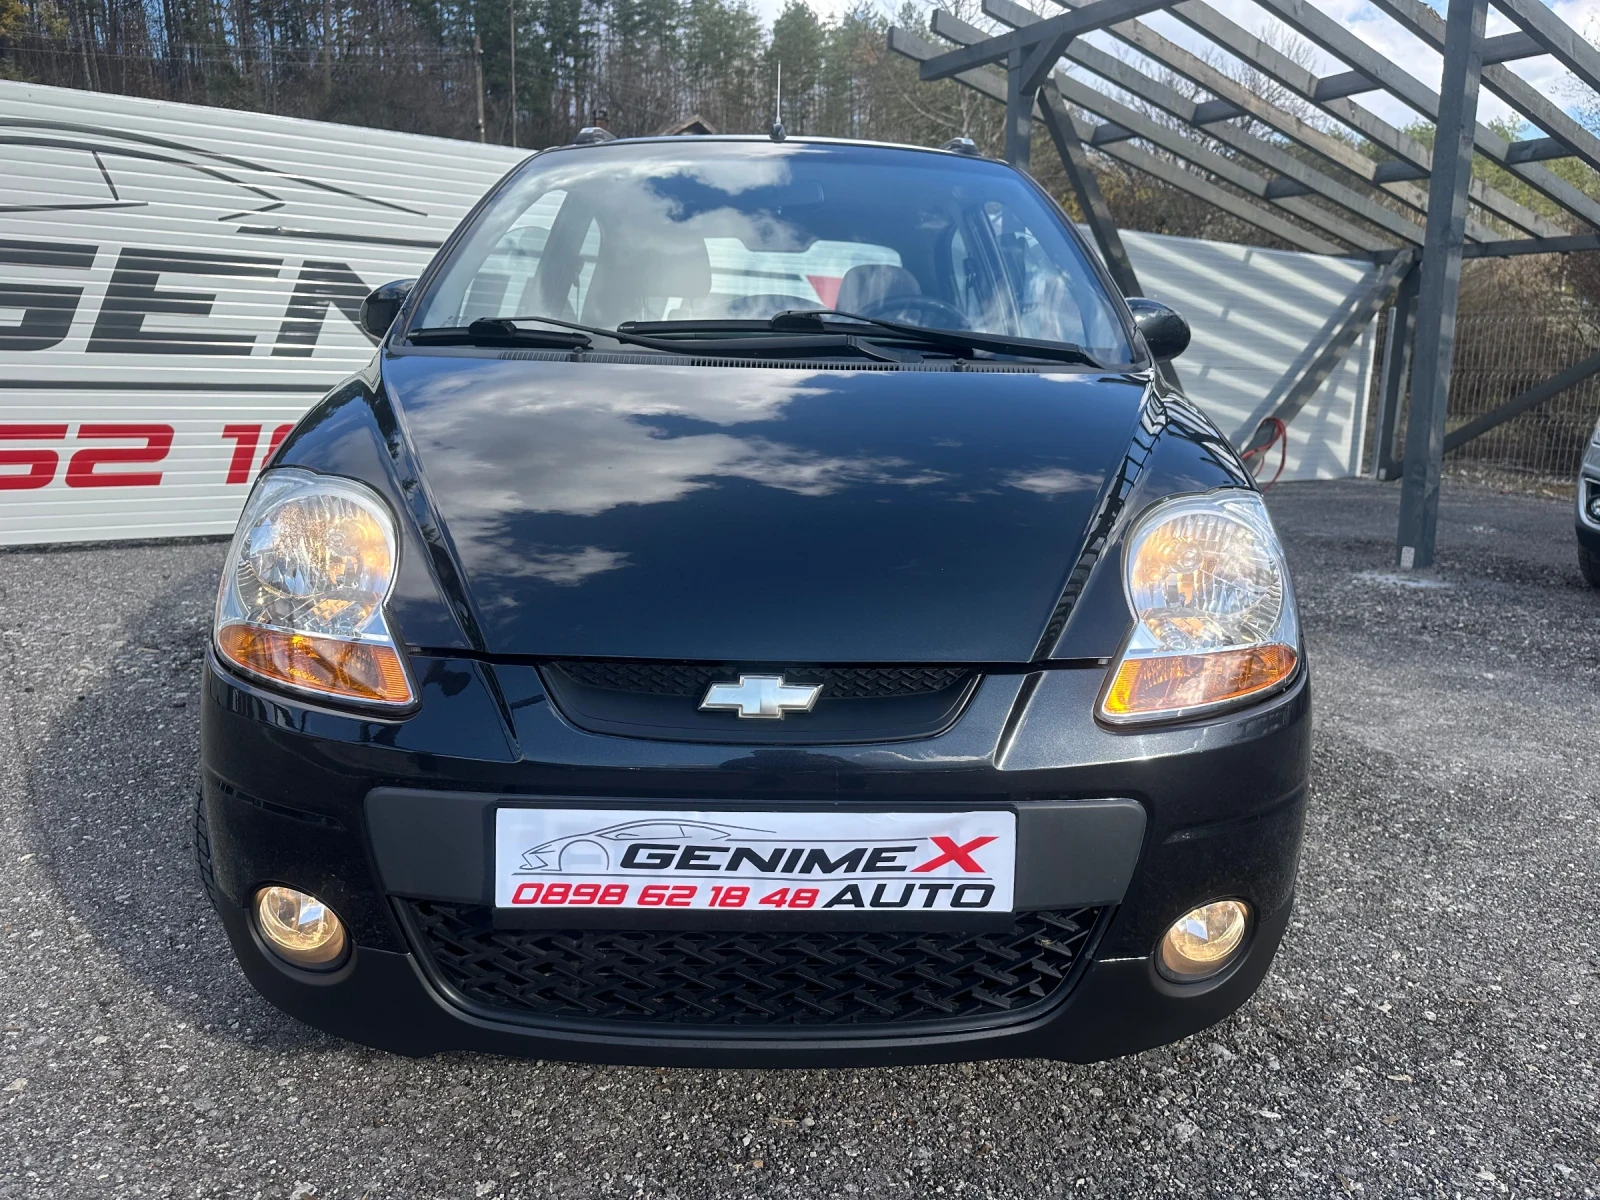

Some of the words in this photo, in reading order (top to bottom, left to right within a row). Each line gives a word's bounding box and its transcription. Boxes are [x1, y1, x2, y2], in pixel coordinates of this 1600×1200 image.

[222, 424, 297, 484] 1
[620, 836, 999, 873] GENIMEX
[511, 883, 629, 905] 0898
[636, 885, 698, 906] 62
[708, 886, 750, 907] 18
[758, 887, 820, 908] 48
[821, 883, 996, 908] AUTO
